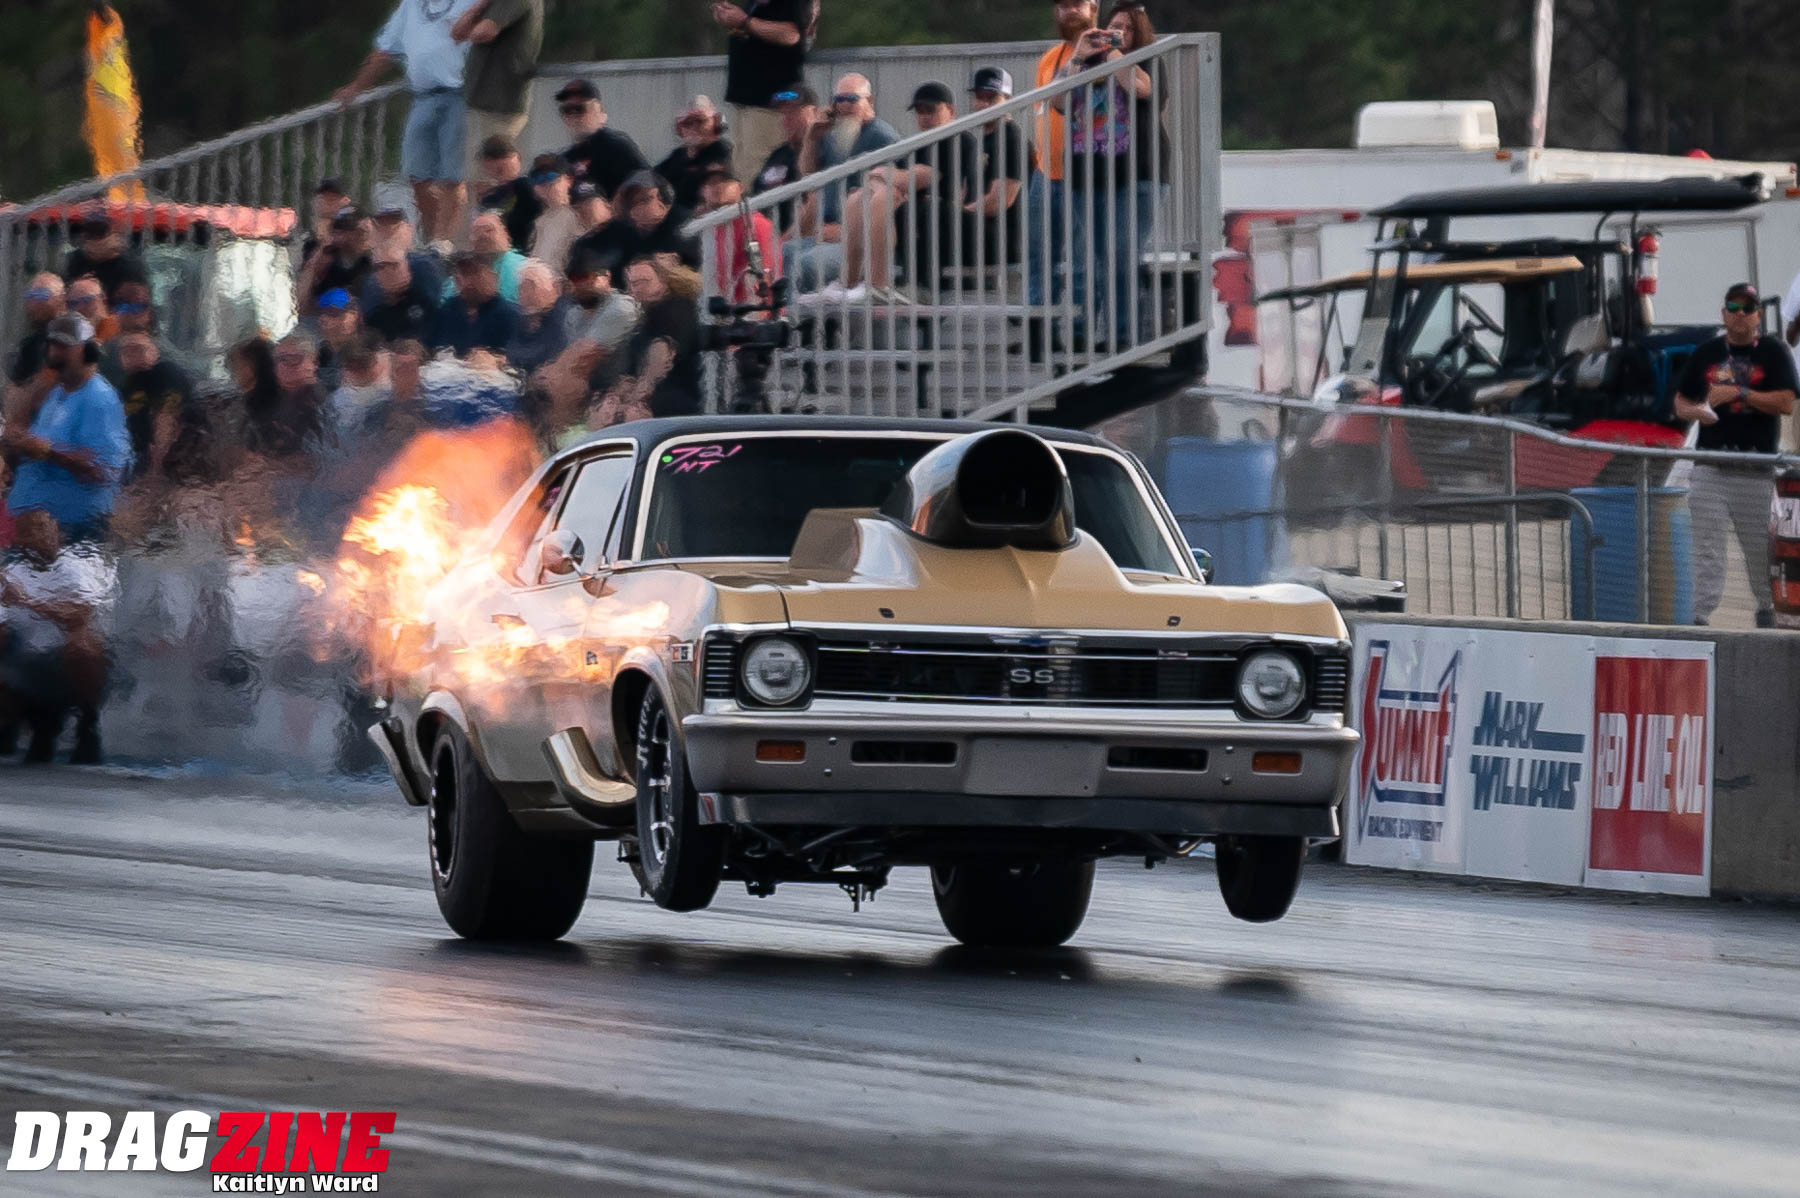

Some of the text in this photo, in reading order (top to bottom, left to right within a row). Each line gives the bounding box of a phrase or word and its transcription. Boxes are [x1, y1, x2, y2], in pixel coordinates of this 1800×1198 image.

[1010, 668, 1054, 684] SS
[1360, 650, 1457, 815] SUMMIT
[1472, 691, 1566, 751] MARK
[1469, 754, 1582, 811] WILLIAMS
[1594, 712, 1704, 814] RED LINE OIL
